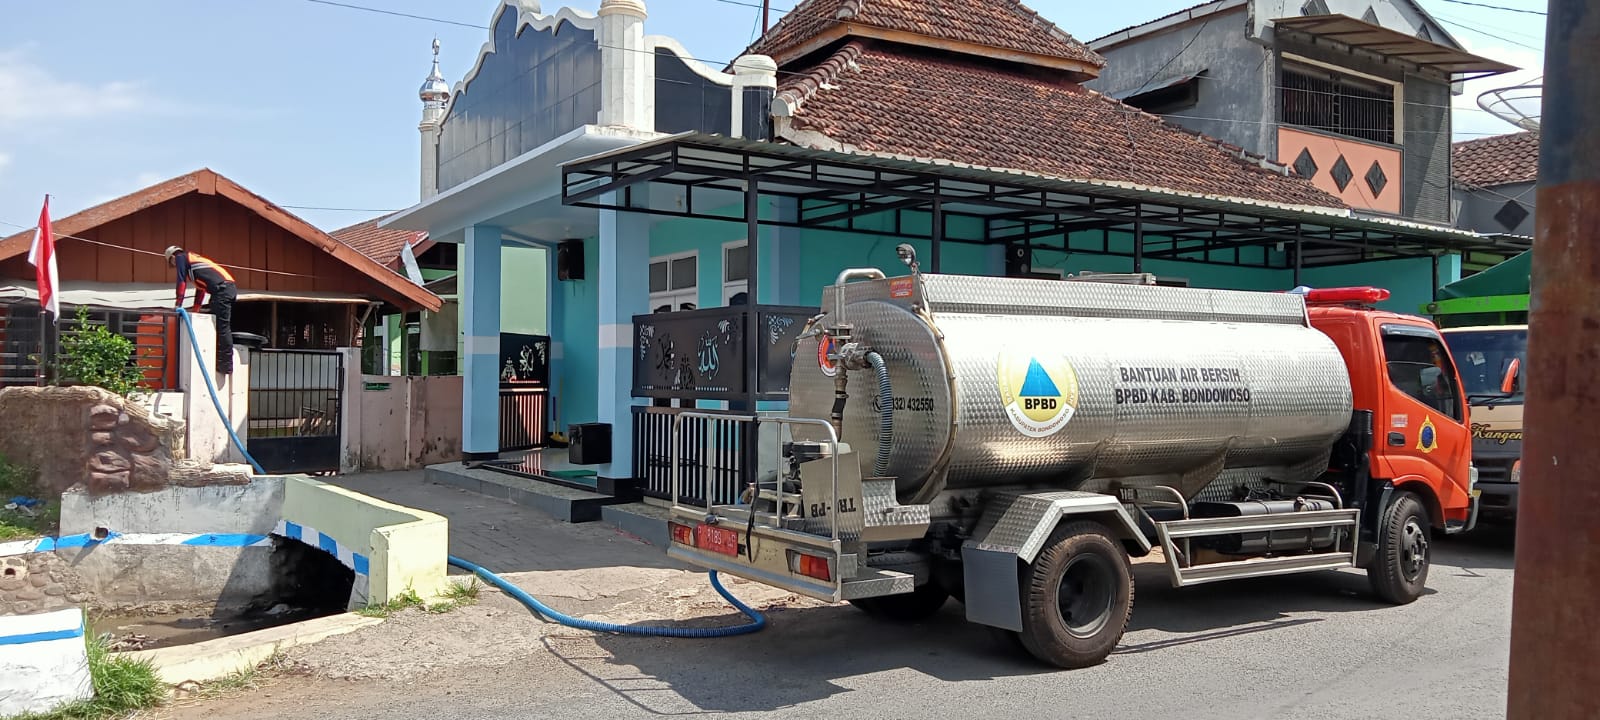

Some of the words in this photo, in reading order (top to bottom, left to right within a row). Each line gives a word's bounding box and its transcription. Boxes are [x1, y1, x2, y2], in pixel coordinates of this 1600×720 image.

[1120, 366, 1177, 382] BANTUAN
[1180, 367, 1200, 382] AIR
[1200, 368, 1241, 382] BERSIH
[907, 397, 934, 411] 432550
[1025, 398, 1057, 410] BPBD
[1116, 388, 1148, 404] BPBD
[1150, 388, 1180, 404] KAB.
[1182, 388, 1250, 403] BONDOWOSO
[1037, 408, 1070, 432] BONDOWOSO
[811, 497, 857, 518] TR-PB
